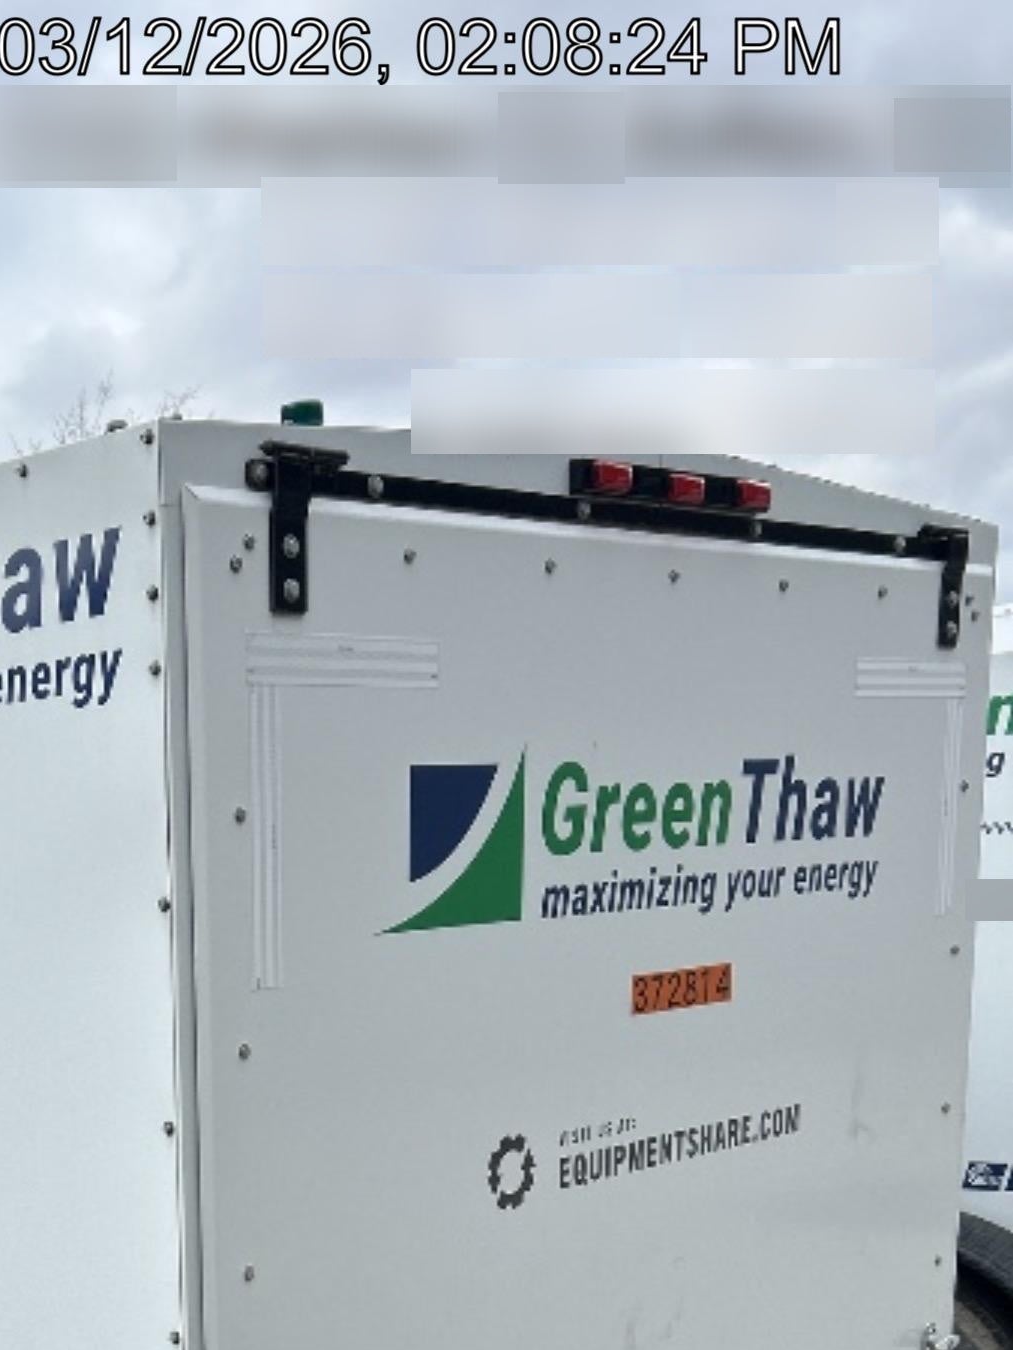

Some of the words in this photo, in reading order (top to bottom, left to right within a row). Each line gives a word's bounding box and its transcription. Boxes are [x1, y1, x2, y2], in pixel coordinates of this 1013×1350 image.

[541, 863, 719, 919] maximizing
[724, 865, 787, 912] your
[793, 859, 880, 899] energy
[633, 967, 731, 1013] 372814
[559, 1103, 802, 1190] EQUIPMENTSHARE.COM
